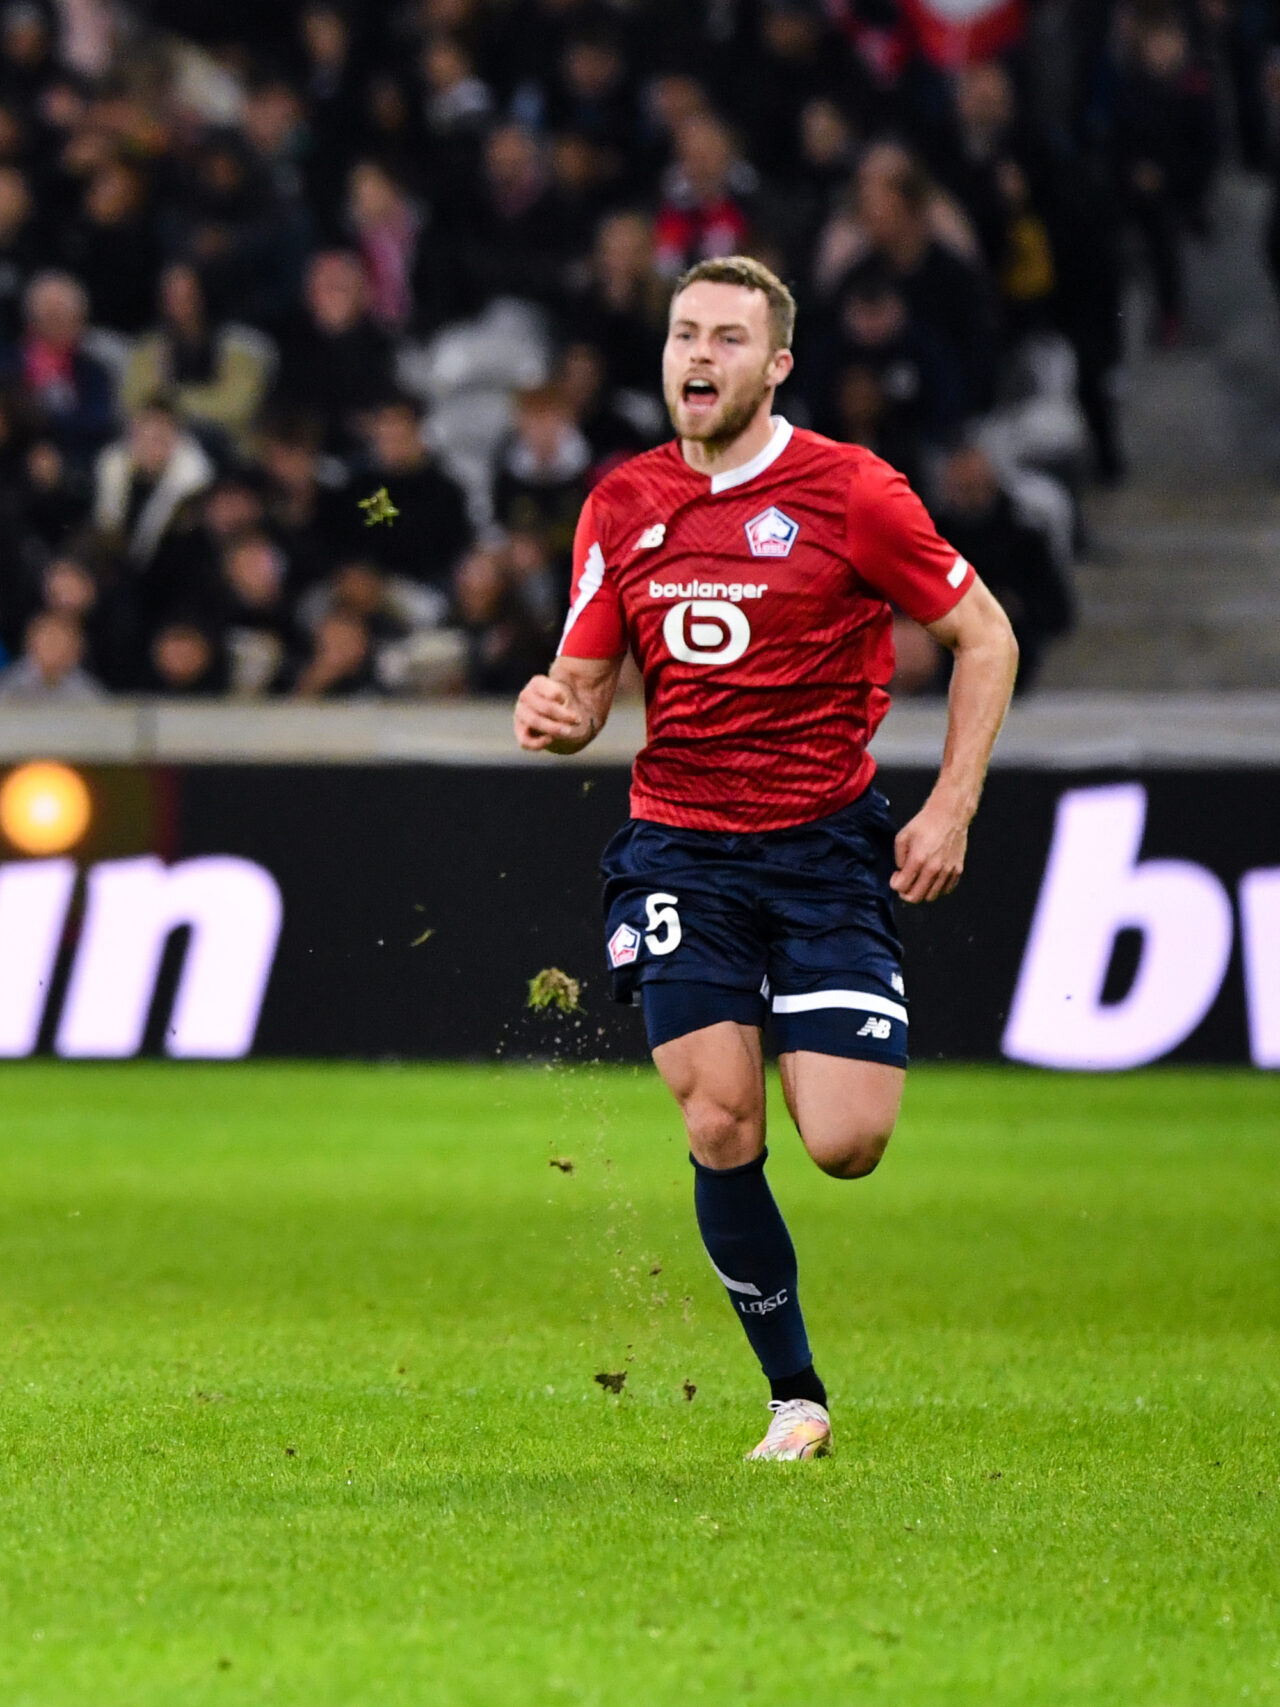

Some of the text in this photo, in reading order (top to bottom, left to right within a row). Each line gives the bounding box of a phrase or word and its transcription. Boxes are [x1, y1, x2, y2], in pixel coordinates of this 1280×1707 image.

[649, 579, 768, 602] boulanger
[645, 893, 682, 955] 5
[856, 1017, 891, 1039] NB
[739, 1288, 788, 1315] LOSC
